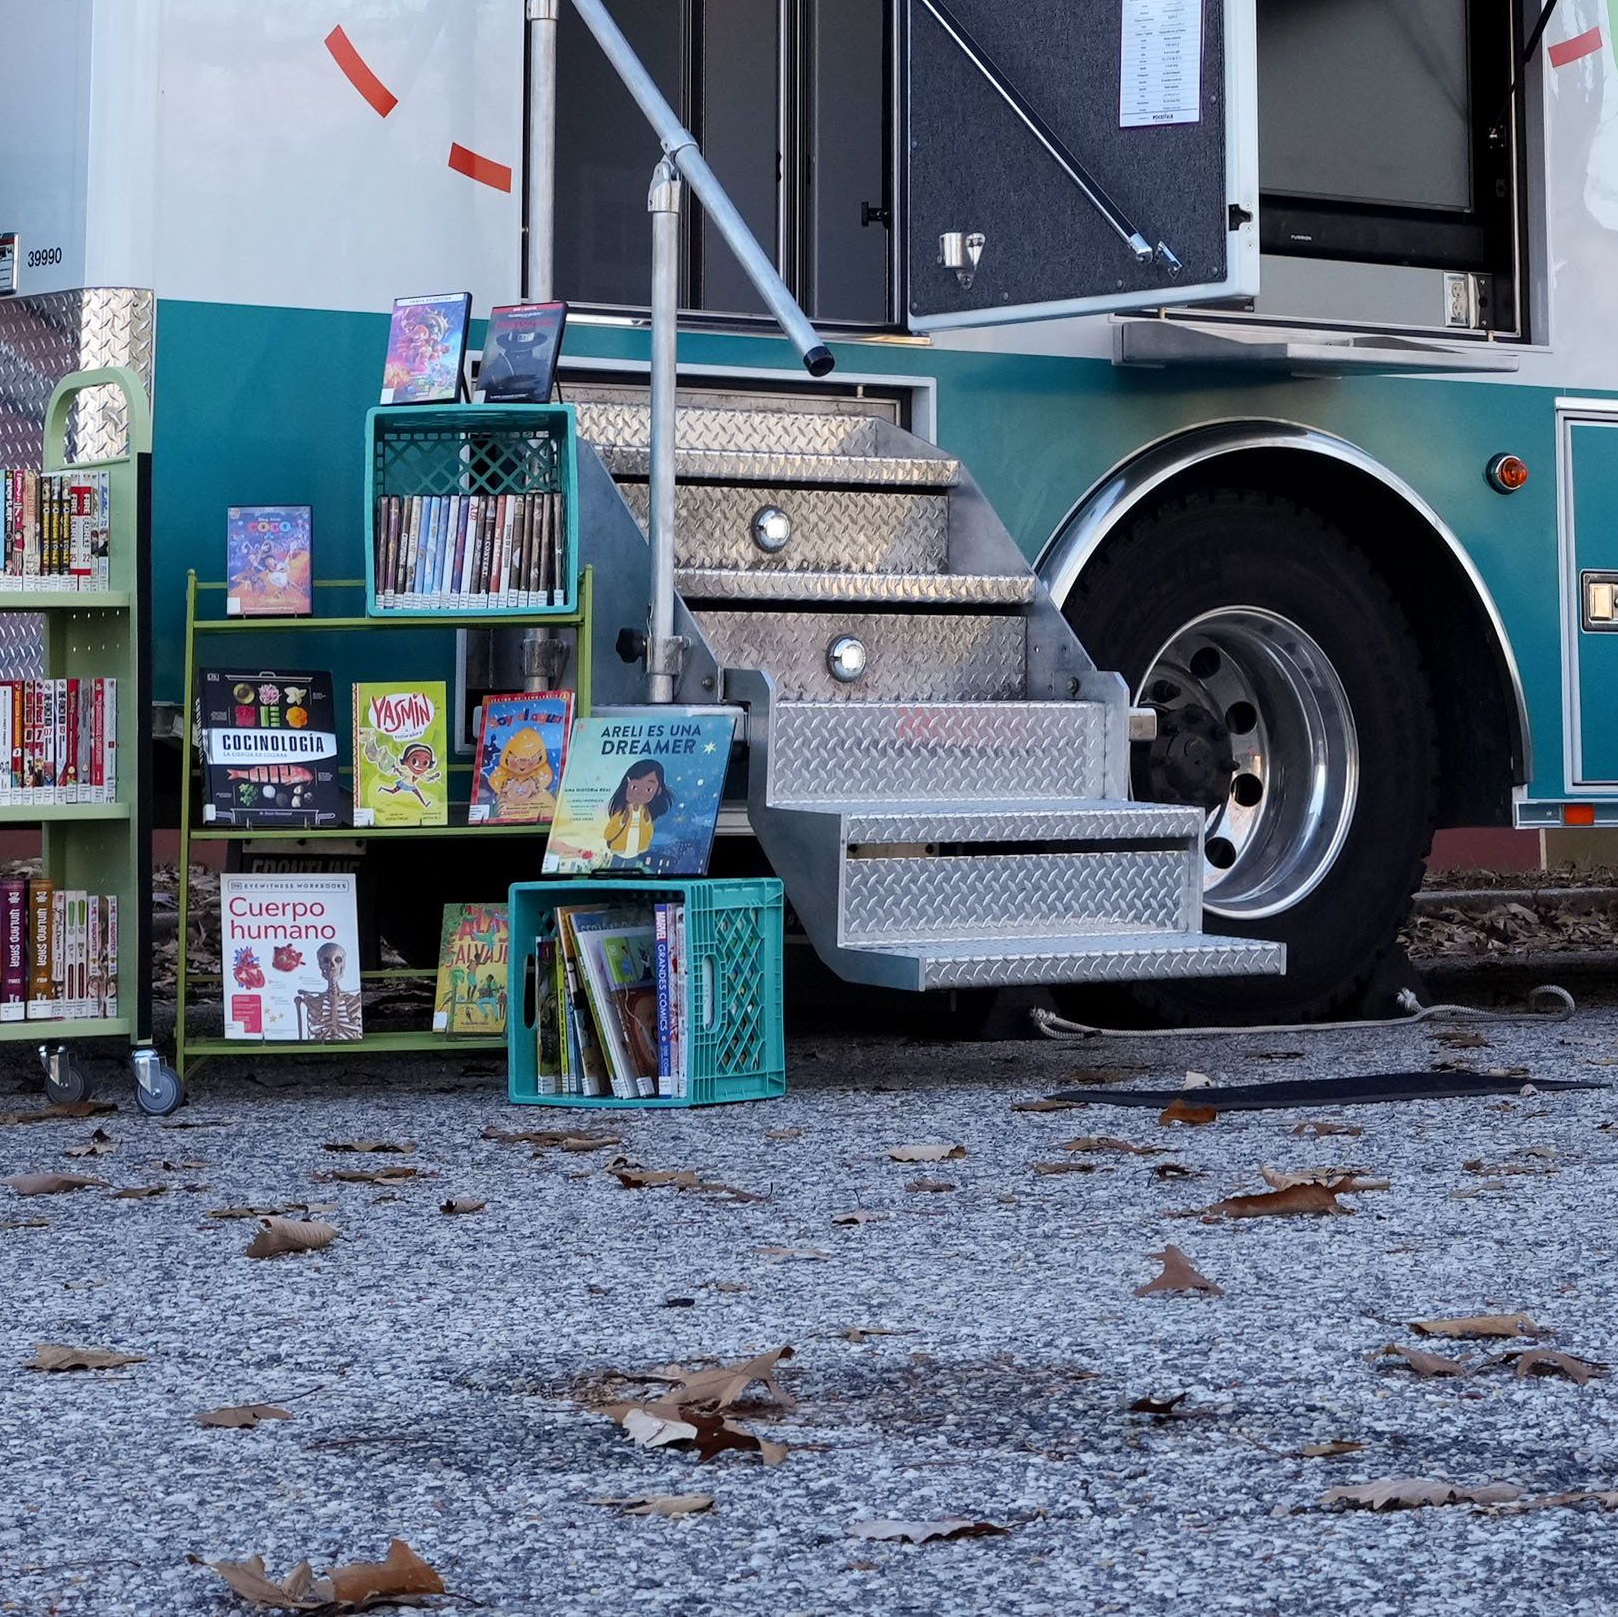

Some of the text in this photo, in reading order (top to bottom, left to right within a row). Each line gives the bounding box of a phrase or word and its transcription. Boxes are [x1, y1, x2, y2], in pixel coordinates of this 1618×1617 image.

[28, 247, 62, 268] 39990
[469, 504, 478, 521] AIR
[248, 521, 291, 532] COCO
[601, 724, 702, 738] ARELI ES UNA
[223, 733, 324, 753] COCINOLOGÍA
[600, 739, 697, 755] DREAMER
[229, 897, 325, 921] Cuerpo
[231, 920, 336, 939] humano
[655, 910, 667, 941] MARVEL
[9, 909, 20, 967] VINLAND SAGA
[37, 908, 47, 966] VINLAND SAGA
[658, 944, 669, 991] GRANDES
[658, 993, 669, 1032] COMICS
